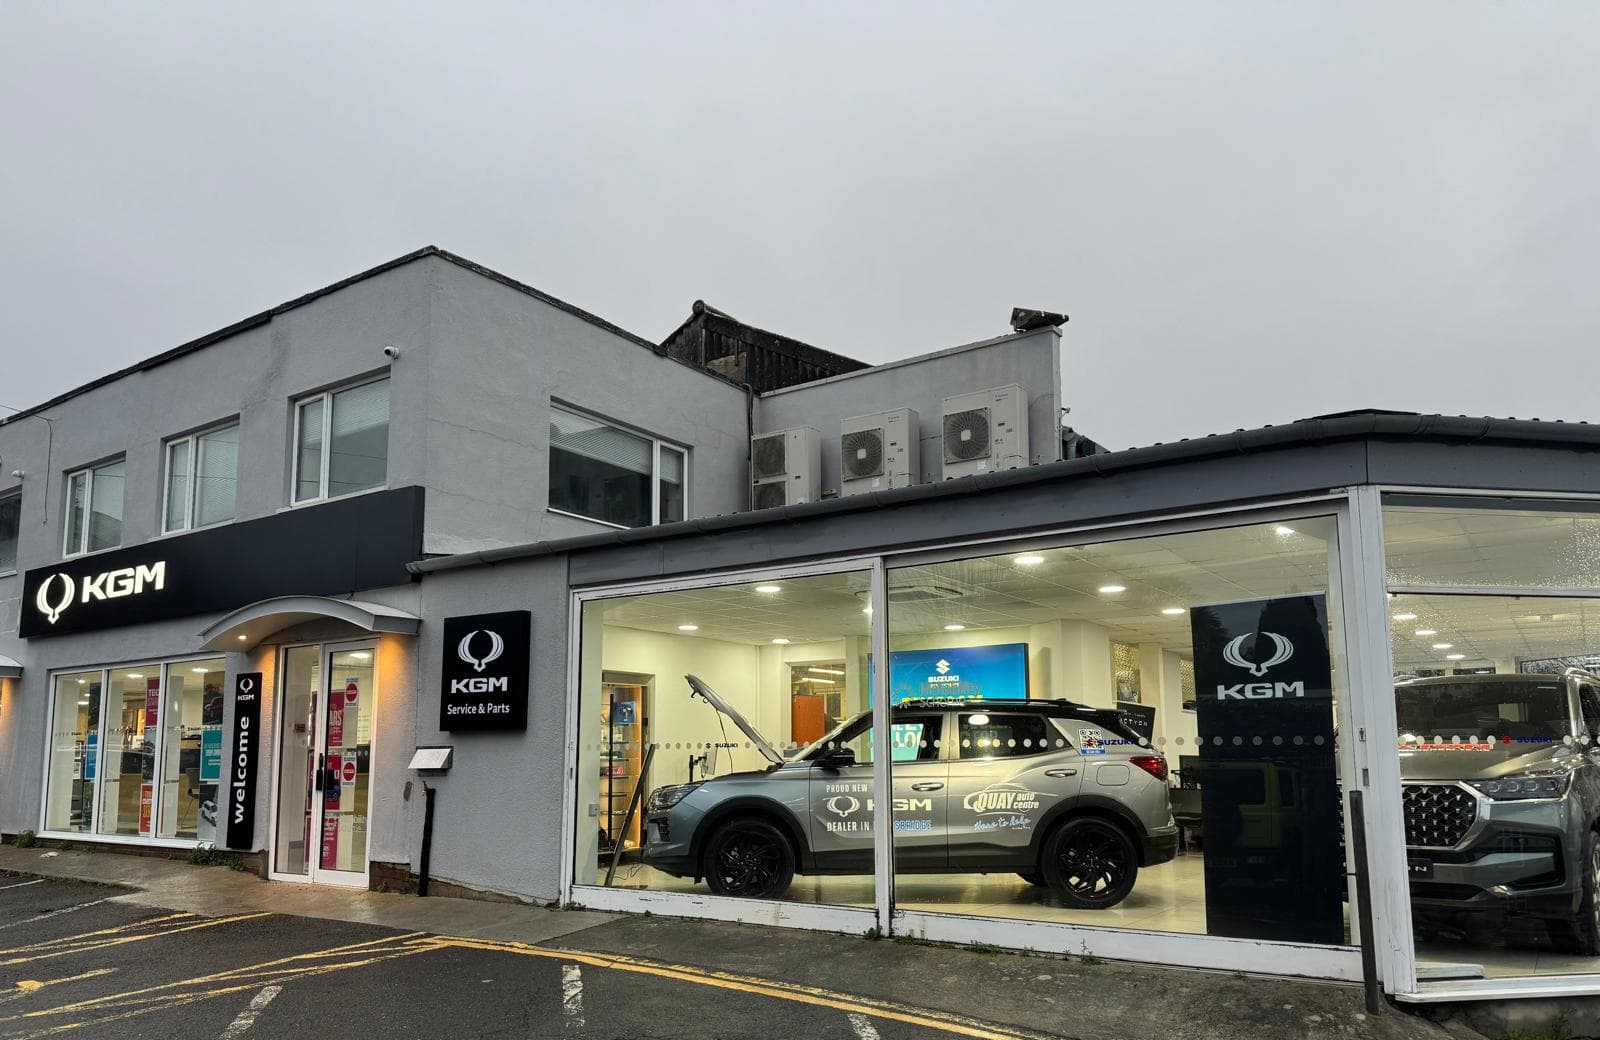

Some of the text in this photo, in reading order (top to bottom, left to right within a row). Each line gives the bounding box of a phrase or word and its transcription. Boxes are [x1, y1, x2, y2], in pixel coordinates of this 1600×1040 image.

[82, 561, 166, 603] KGM
[451, 676, 508, 694] KGM
[928, 675, 960, 683] SUZUKI
[1217, 681, 1305, 701] KGM
[447, 702, 510, 715] Service & Parts
[234, 716, 250, 825] welcome
[826, 784, 850, 793] PROUD
[973, 791, 1035, 813] QUAY auto
[1013, 800, 1040, 809] centre
[826, 821, 858, 832] DEALER
[861, 821, 870, 832] IN
